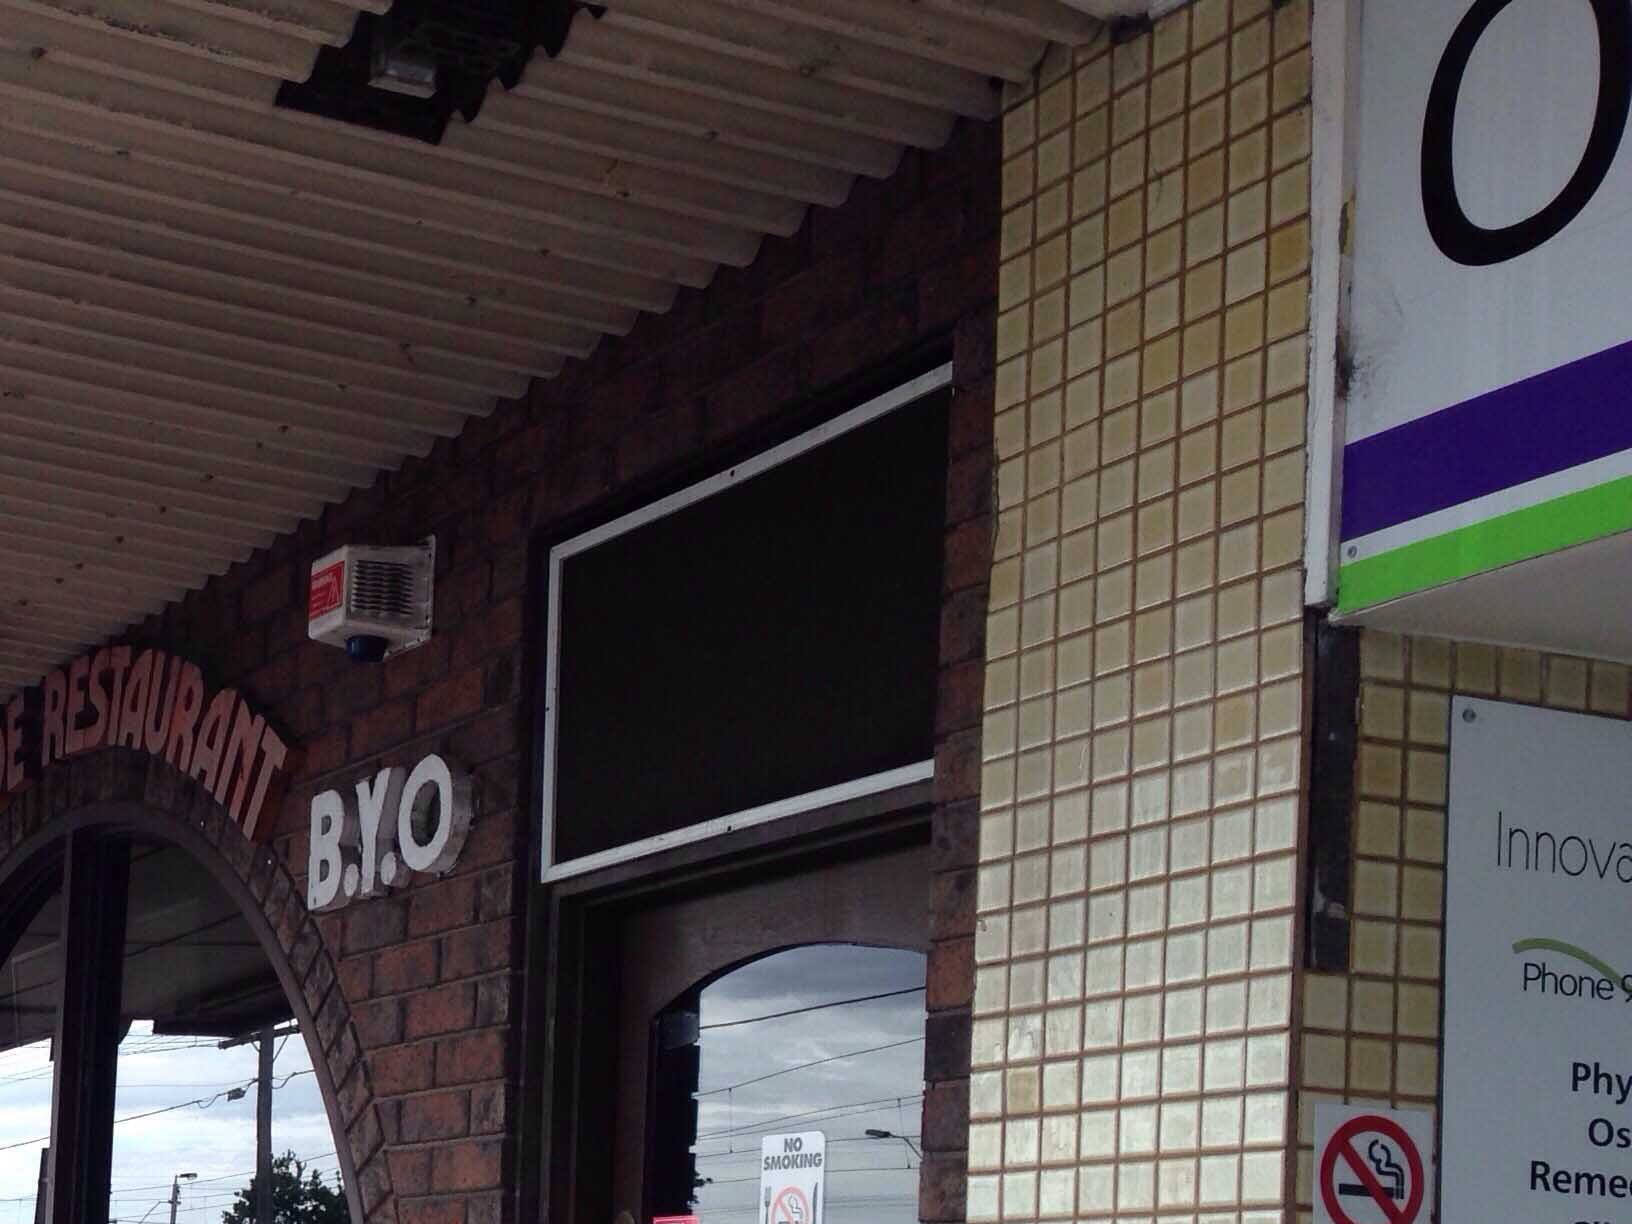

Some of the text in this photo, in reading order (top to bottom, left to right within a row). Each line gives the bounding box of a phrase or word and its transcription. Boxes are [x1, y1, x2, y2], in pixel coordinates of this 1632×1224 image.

[40, 645, 289, 841] RESTAURANT
[306, 752, 454, 911] B.Y.O
[1523, 961, 1615, 1001] Phone
[783, 1136, 803, 1153] NO
[1588, 1117, 1632, 1149] Os
[763, 1152, 823, 1171] SMOKING
